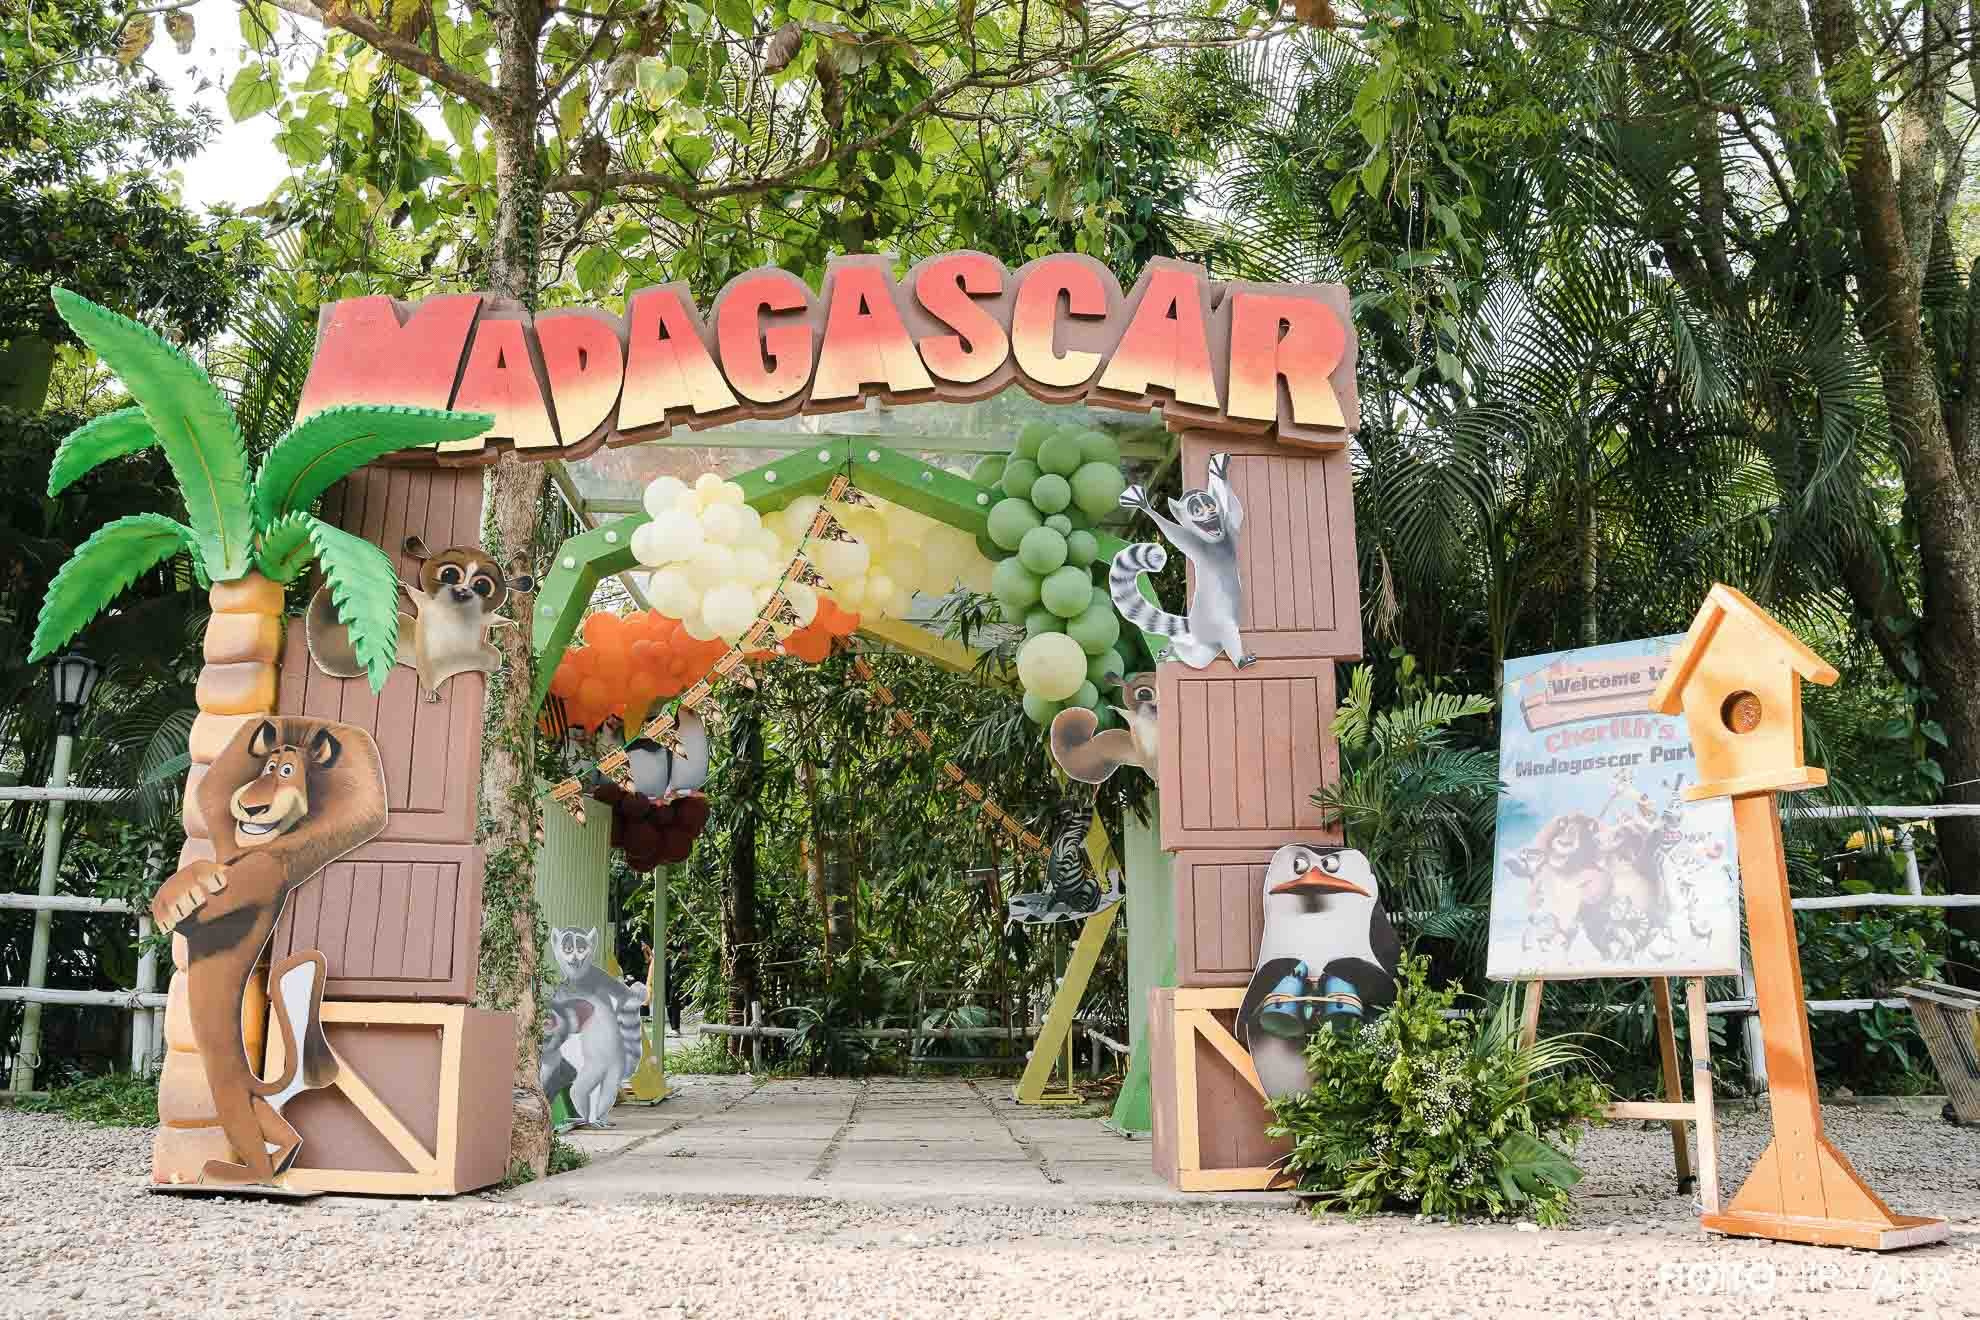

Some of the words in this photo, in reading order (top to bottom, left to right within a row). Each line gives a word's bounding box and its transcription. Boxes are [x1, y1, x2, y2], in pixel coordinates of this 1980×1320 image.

[296, 254, 1348, 452] MADAGASCAR
[1552, 671, 1640, 696] Welcome
[1515, 751, 1643, 777] Madagascar
